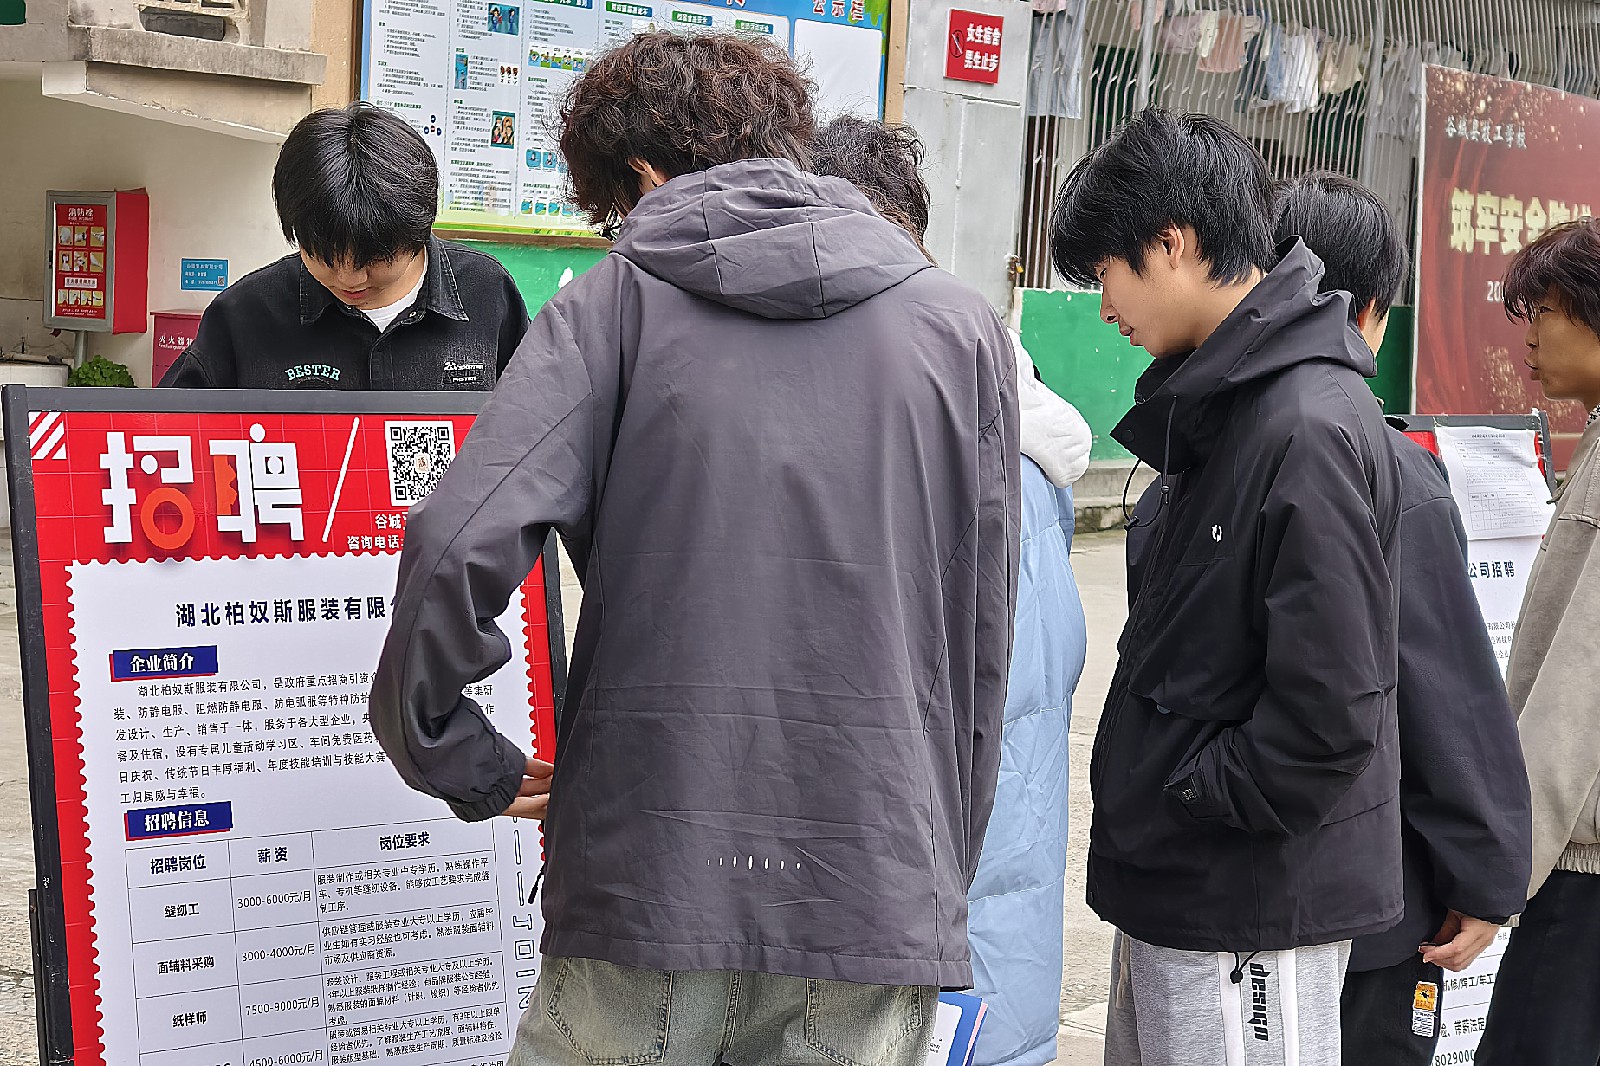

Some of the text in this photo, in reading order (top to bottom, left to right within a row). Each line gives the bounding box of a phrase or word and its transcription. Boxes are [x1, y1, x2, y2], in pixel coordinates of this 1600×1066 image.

[963, 49, 999, 73] 男生止步
[1450, 187, 1592, 256] 筑牢安全
[285, 364, 341, 381] BESTER
[100, 422, 305, 550] 招聘
[1469, 560, 1515, 579] 公司招聘
[175, 596, 397, 628] 湖北柏奴斯服装有限
[130, 652, 195, 673] 企业简介
[144, 809, 210, 832] 招聘信息
[150, 853, 207, 875] 招聘岗位
[379, 831, 431, 851] 岗位要求
[164, 902, 200, 918] 缝纫工
[157, 956, 215, 975] 面辅料采购
[1247, 962, 1272, 1043] design
[172, 1010, 207, 1028] 纸样师
